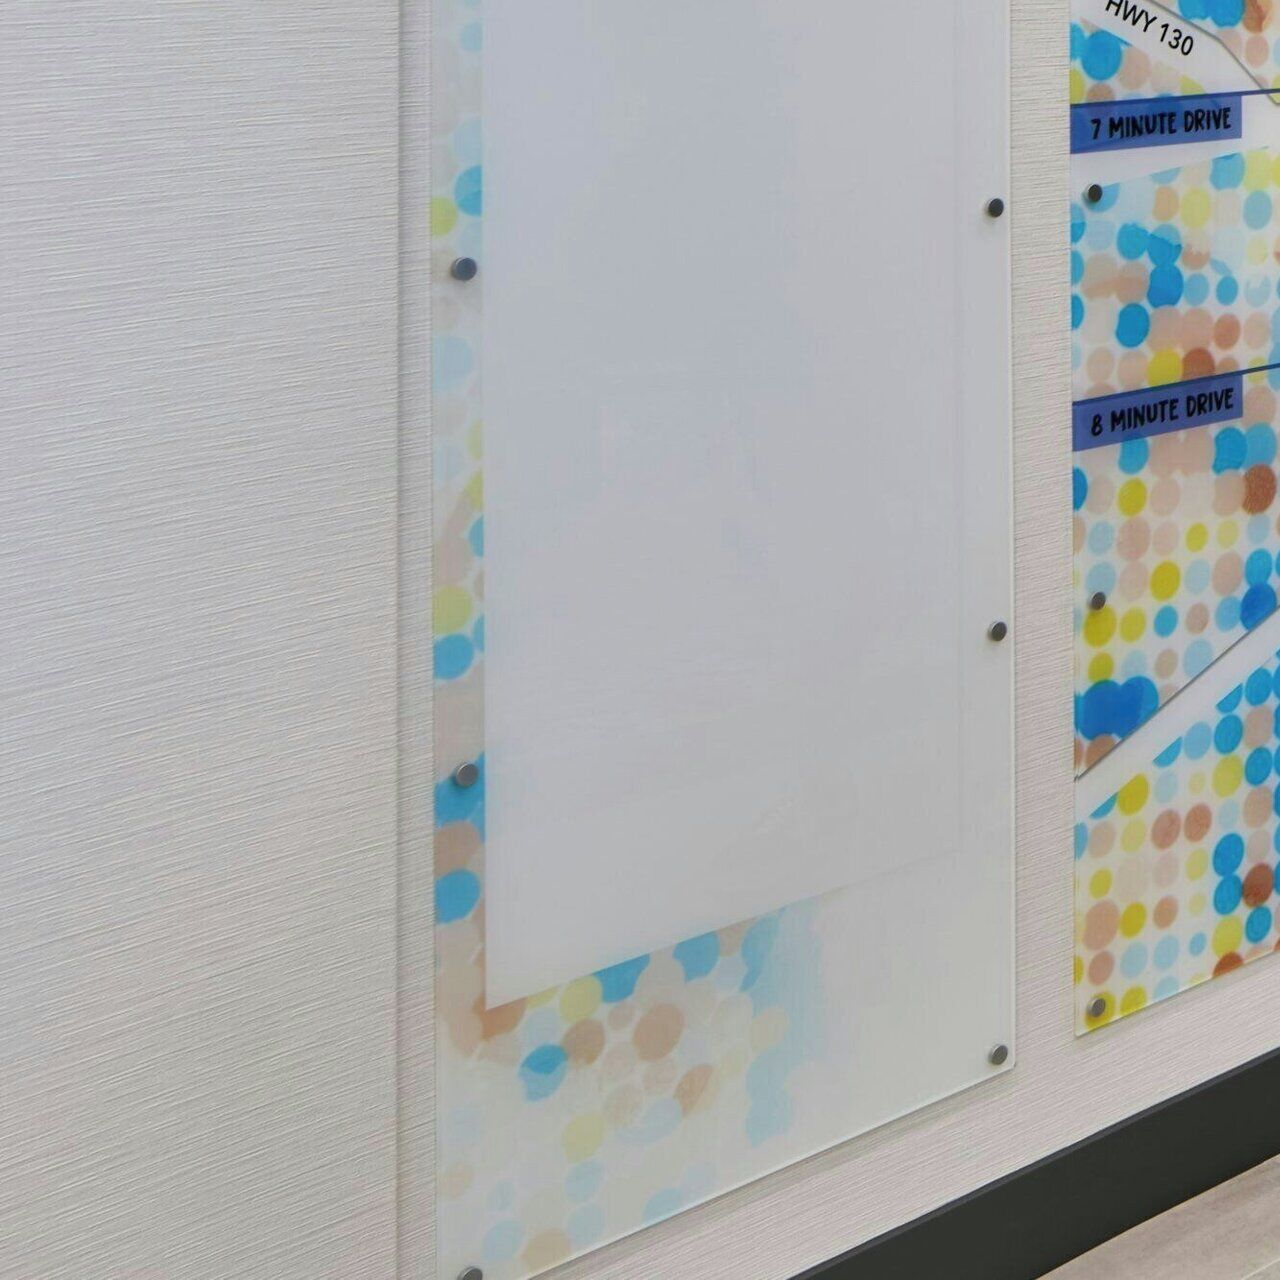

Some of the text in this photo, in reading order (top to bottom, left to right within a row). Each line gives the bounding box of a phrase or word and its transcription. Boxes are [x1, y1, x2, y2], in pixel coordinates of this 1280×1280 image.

[1159, 24, 1194, 56] 130
[1090, 107, 1232, 139] 7 MINUTE DRIVE
[1090, 388, 1235, 437] 8 MINUTE DRIVE
